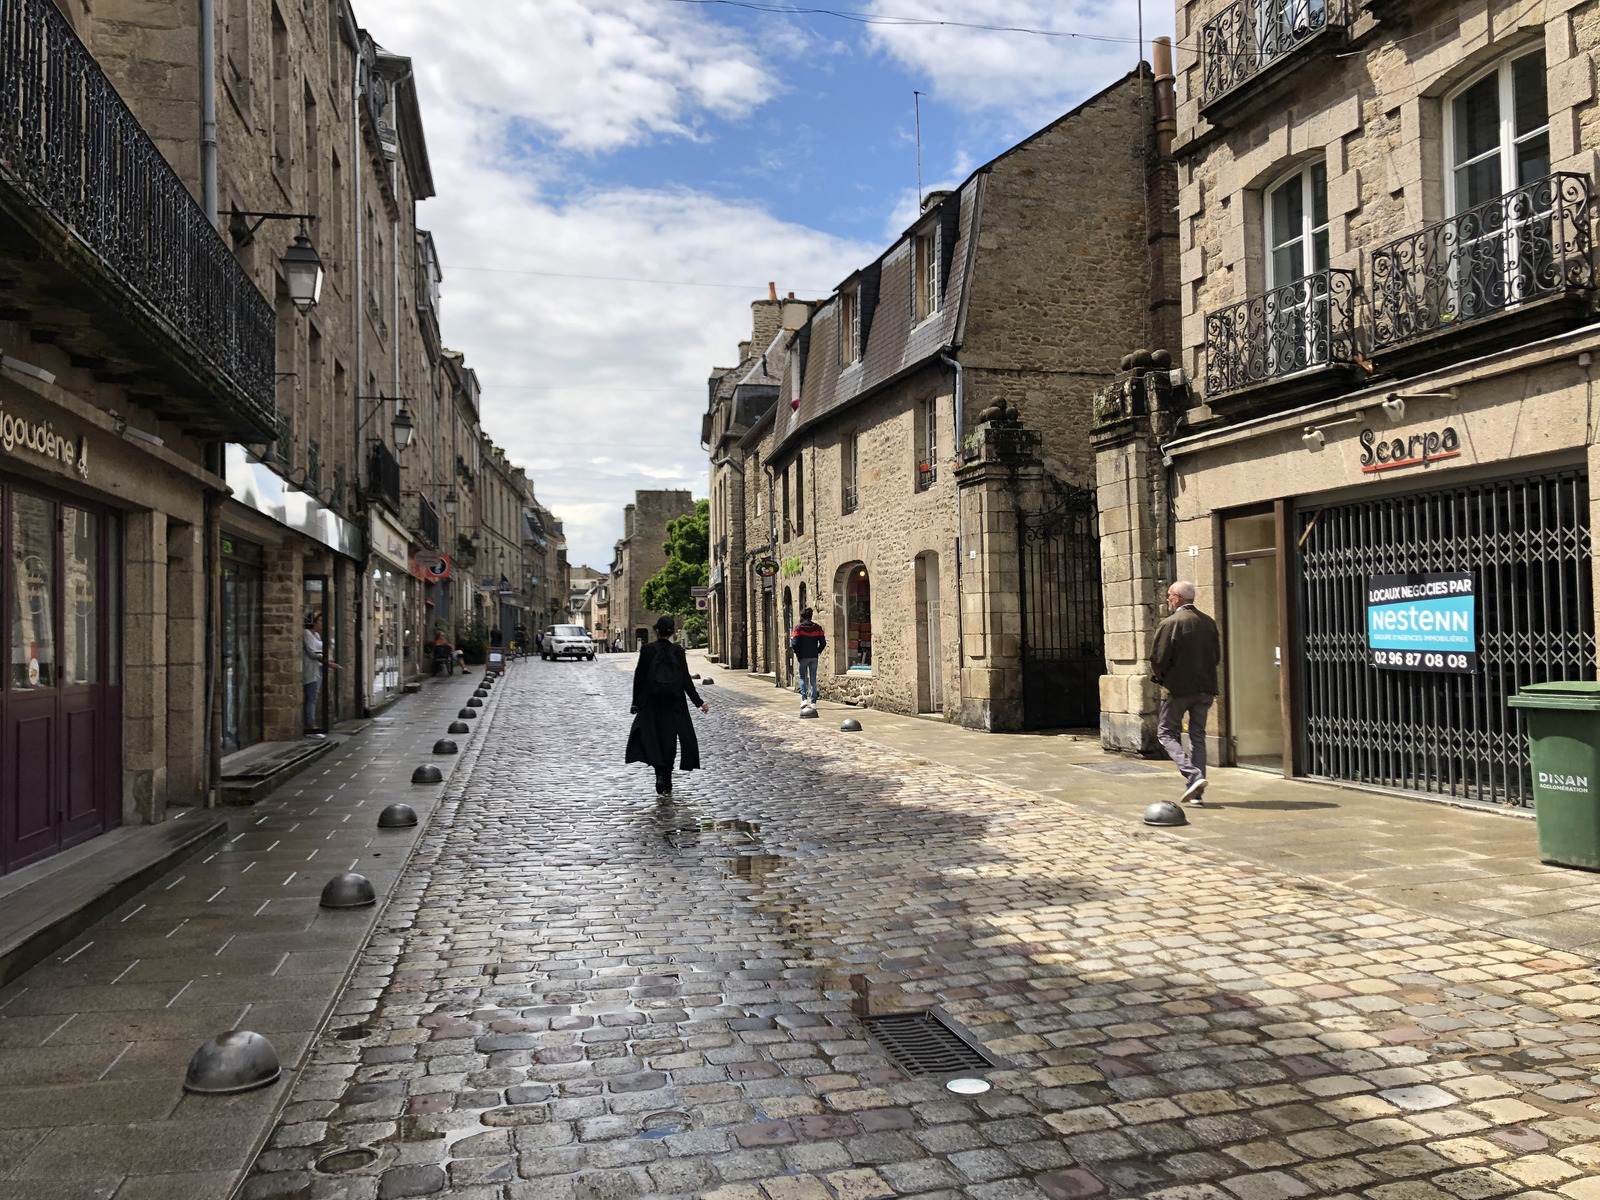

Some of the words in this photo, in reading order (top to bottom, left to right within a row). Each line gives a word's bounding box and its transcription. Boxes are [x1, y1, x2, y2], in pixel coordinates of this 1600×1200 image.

[1360, 427, 1459, 467] Scarpa
[1369, 587, 1401, 603] LOCAUX
[1401, 581, 1448, 599] NEGOCIES
[1449, 579, 1472, 594] PAR
[1374, 651, 1387, 665] 02
[1388, 651, 1403, 666] 96
[1405, 652, 1422, 667] 87
[1424, 653, 1444, 668] 08
[1447, 654, 1468, 669] 08
[1538, 772, 1588, 787] DINAN
